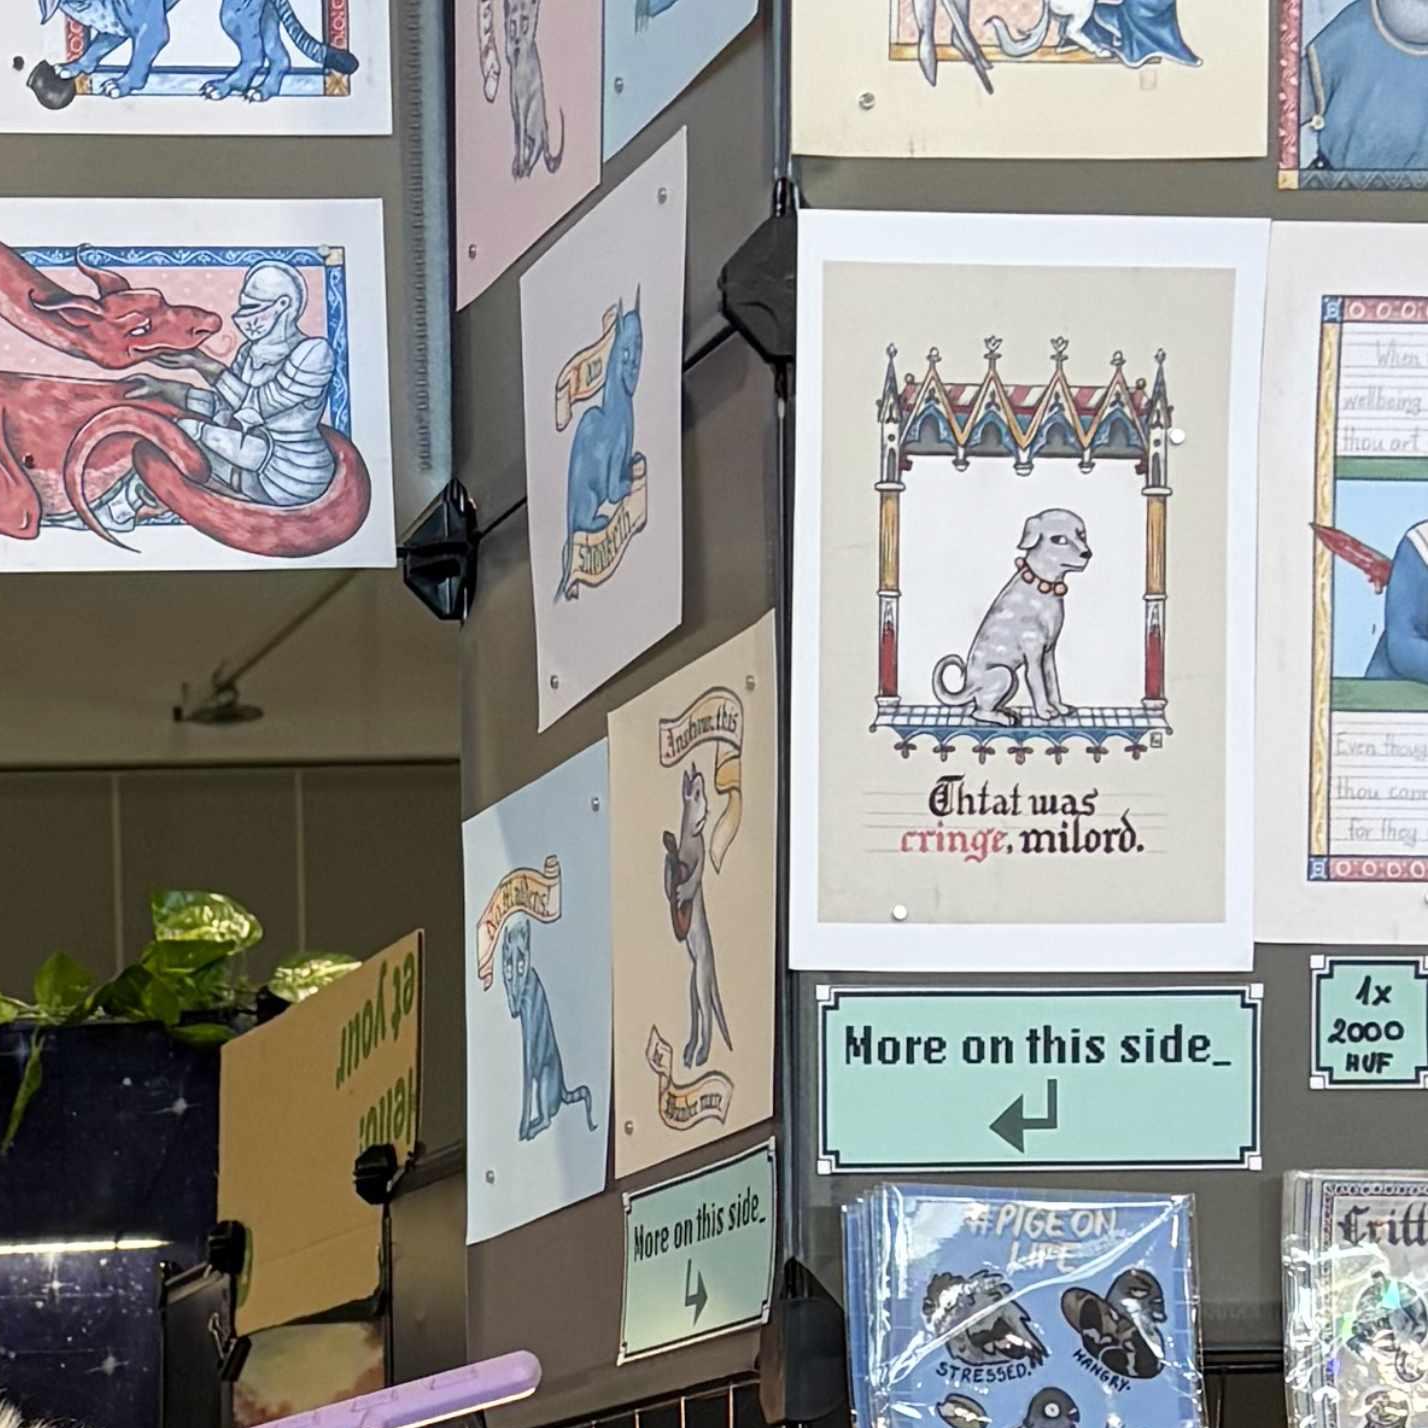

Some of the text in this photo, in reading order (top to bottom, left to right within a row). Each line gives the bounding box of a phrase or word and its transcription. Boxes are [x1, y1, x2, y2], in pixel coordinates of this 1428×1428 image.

[1031, 788, 1097, 817] was
[901, 812, 1145, 862] cringe, milord.
[1355, 977, 1391, 1007] 1x
[845, 1027, 946, 1066] More
[962, 1033, 1011, 1066] on
[1025, 1025, 1105, 1064] this
[1328, 1019, 1405, 1044] 2000
[1345, 1053, 1391, 1075] HUF
[633, 1220, 668, 1261] More
[674, 1215, 693, 1247] on
[697, 1201, 723, 1241] this
[935, 1361, 1033, 1383] STRESSED.
[1073, 1348, 1132, 1393] HANGRY.
